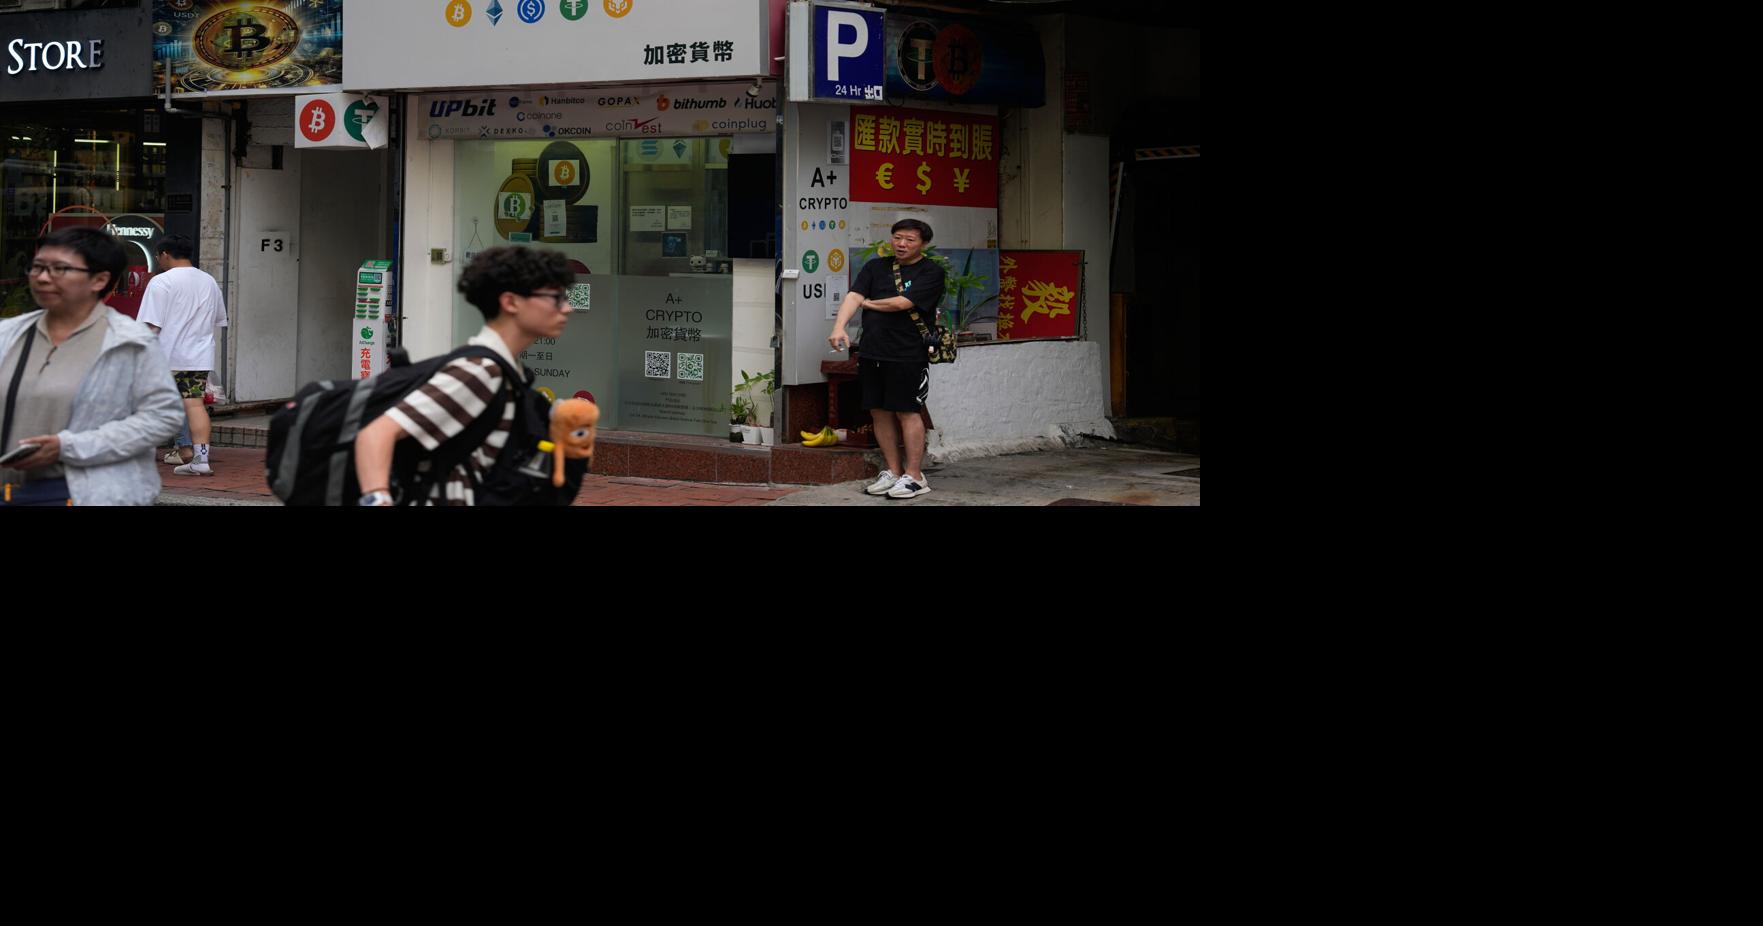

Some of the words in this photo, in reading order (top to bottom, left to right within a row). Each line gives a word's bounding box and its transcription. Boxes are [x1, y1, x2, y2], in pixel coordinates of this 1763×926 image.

[827, 10, 869, 81] P
[643, 41, 734, 65] 加密貨幣
[835, 84, 847, 95] 24
[850, 85, 861, 96] Hr
[864, 85, 883, 100] 出口
[598, 97, 640, 105] GOPAX
[673, 98, 727, 109] bithumb
[712, 119, 767, 131] coinplug
[811, 167, 837, 188] A+
[800, 197, 848, 210] CRYPTO
[106, 223, 155, 239] Hennessy
[803, 283, 826, 299] US
[665, 293, 682, 304] A+
[645, 309, 703, 323] CRYPTO
[646, 326, 702, 342] 加密貨幣
[534, 368, 570, 378] SUNDAY
